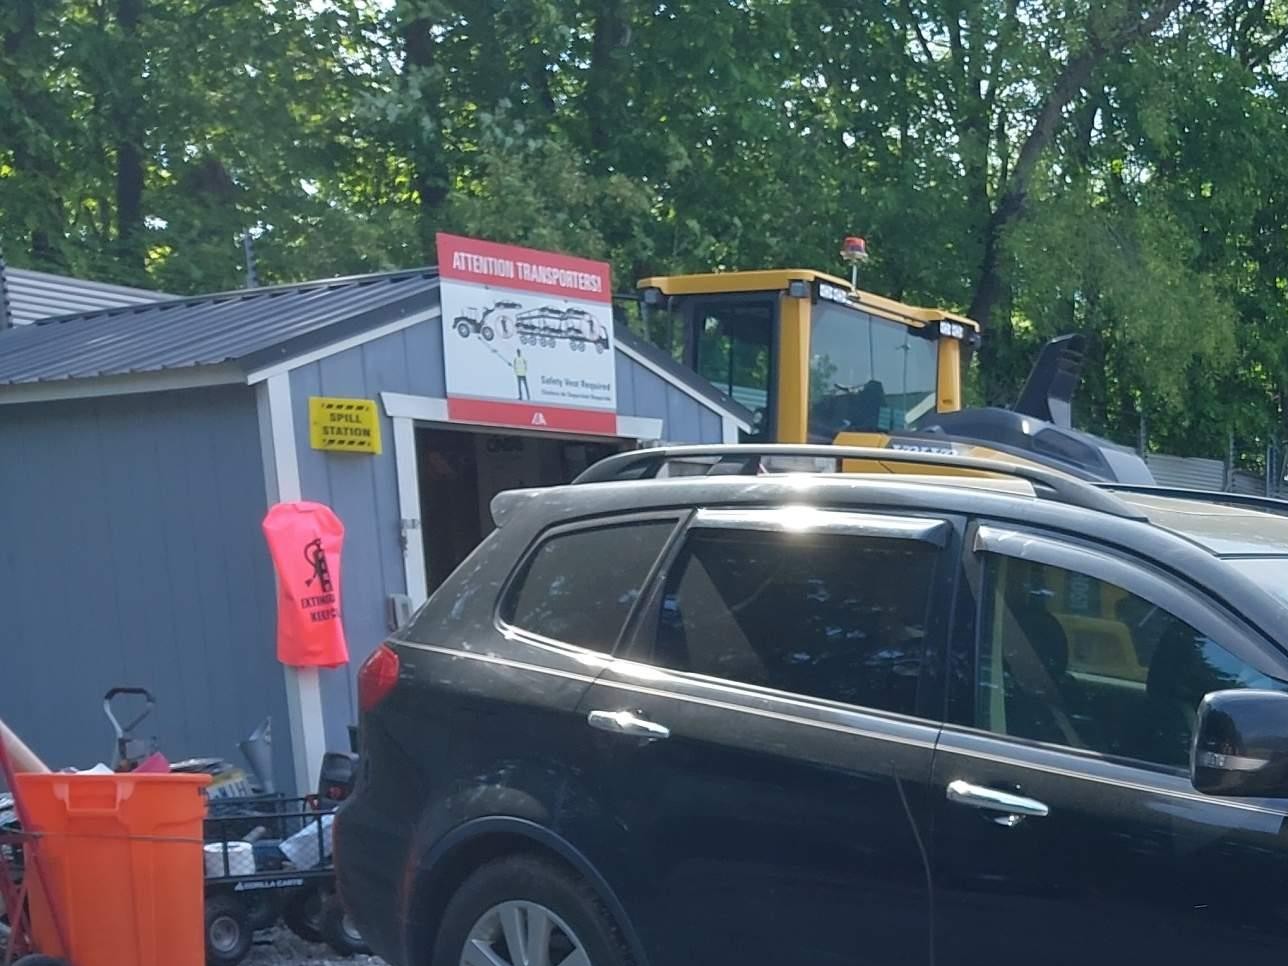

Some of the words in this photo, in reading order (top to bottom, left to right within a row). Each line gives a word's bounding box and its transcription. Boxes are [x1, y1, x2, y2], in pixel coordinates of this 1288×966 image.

[453, 251, 514, 278] ATTENTION
[517, 262, 601, 292] TRANSPORTERS!
[329, 412, 363, 424] SPILL
[322, 425, 371, 437] STATION
